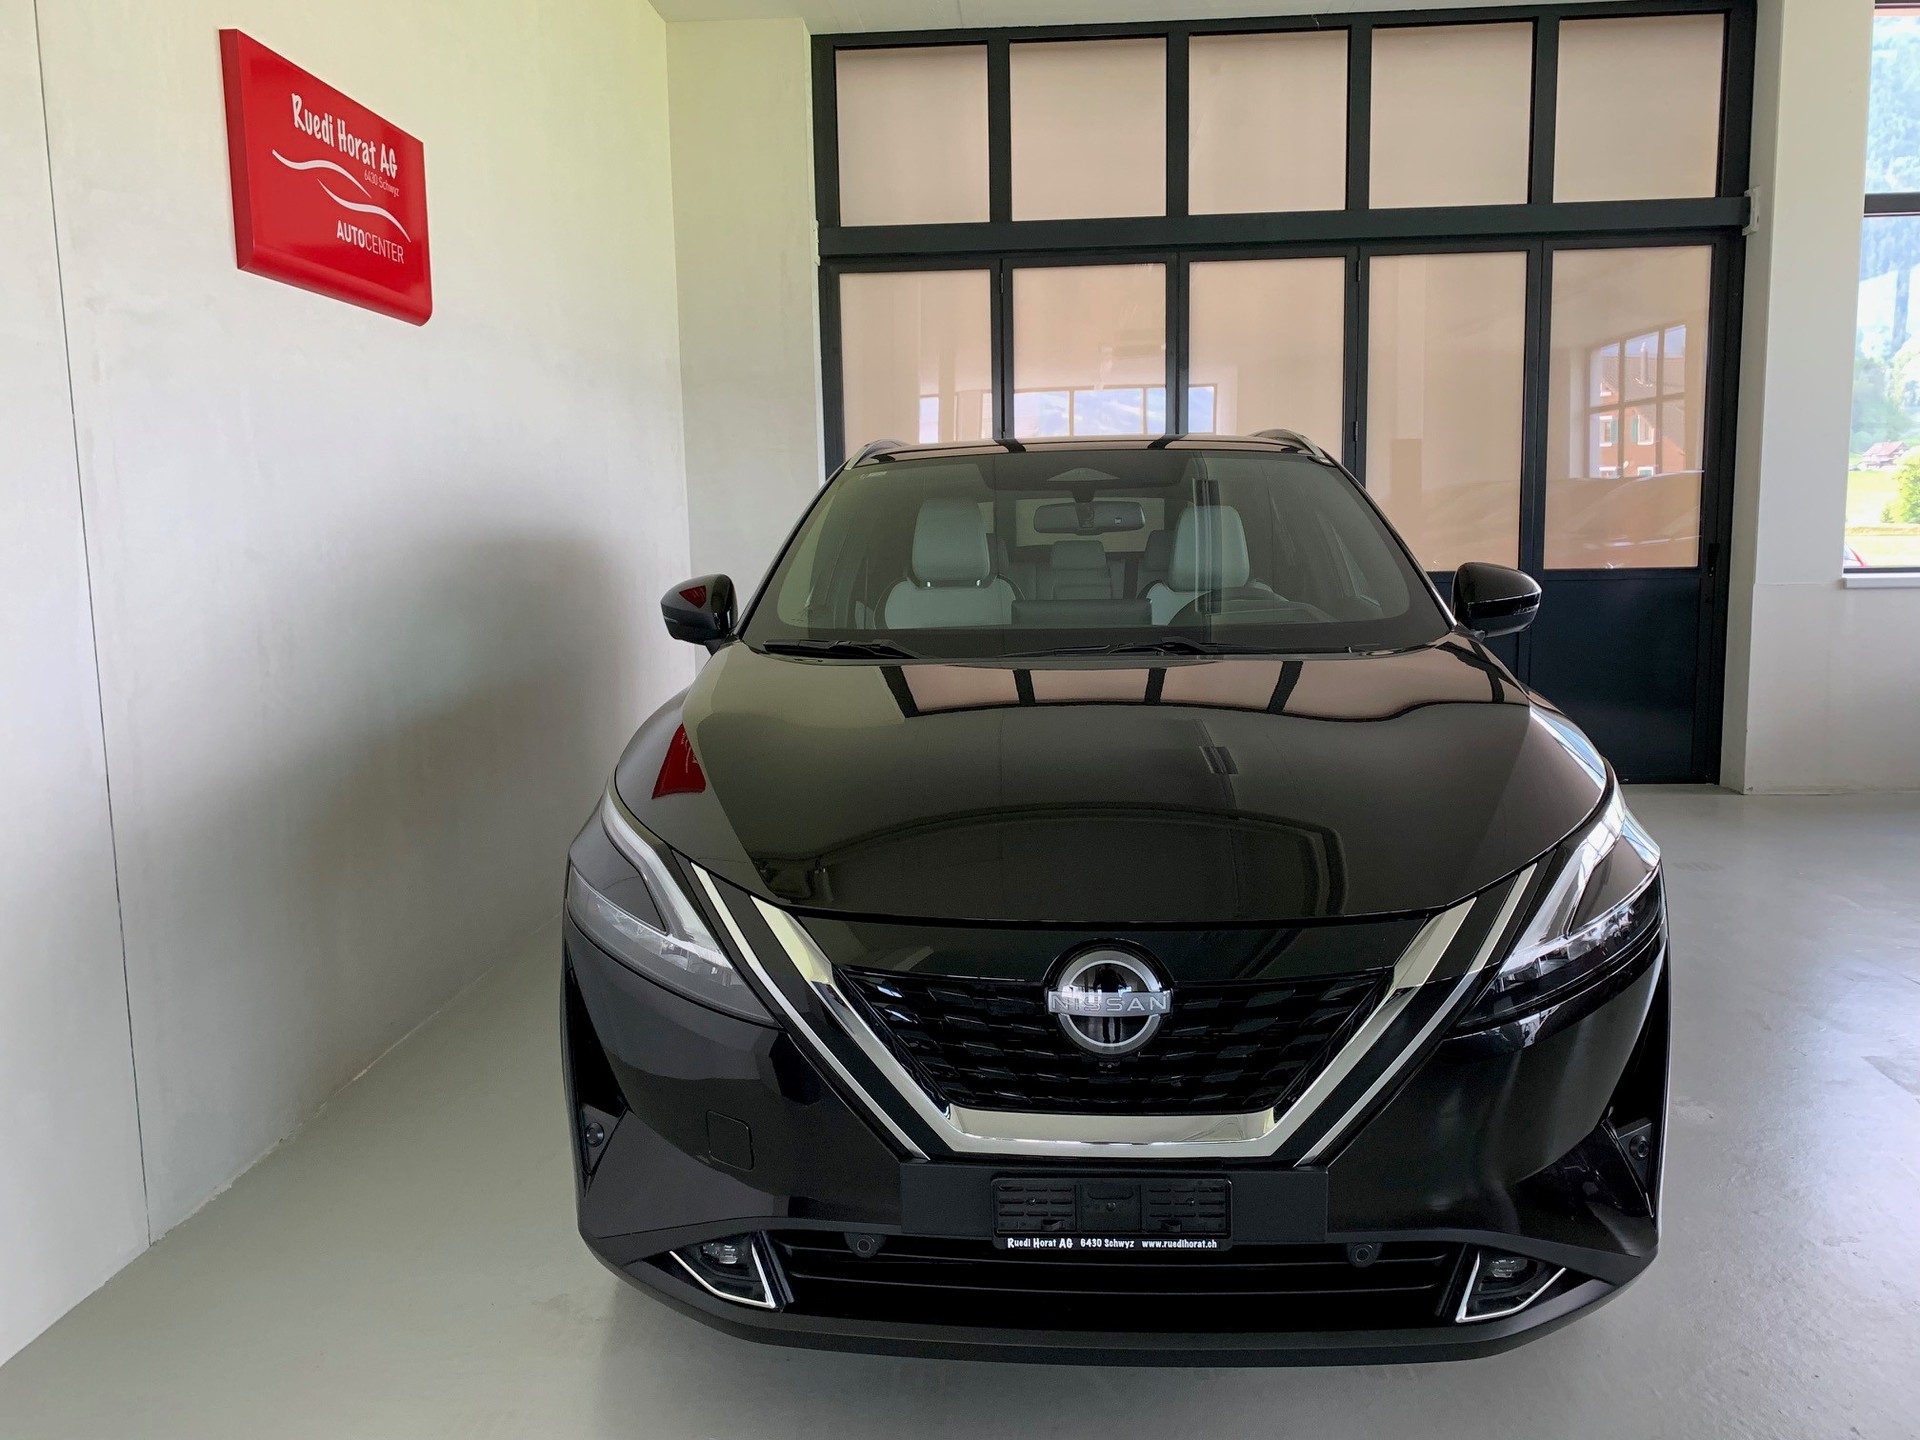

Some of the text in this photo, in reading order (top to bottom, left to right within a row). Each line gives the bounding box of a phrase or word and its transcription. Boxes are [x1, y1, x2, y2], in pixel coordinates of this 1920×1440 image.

[292, 92, 398, 179] Ruedi Horat AG
[364, 169, 400, 198] 6430 Schwyz
[336, 219, 404, 264] AUTOCENTER
[1052, 996, 1166, 1012] NISSAN
[1007, 1237, 1218, 1249] Ruedi Horat AG 6430 Schwyz www.ruedihorat.ch
